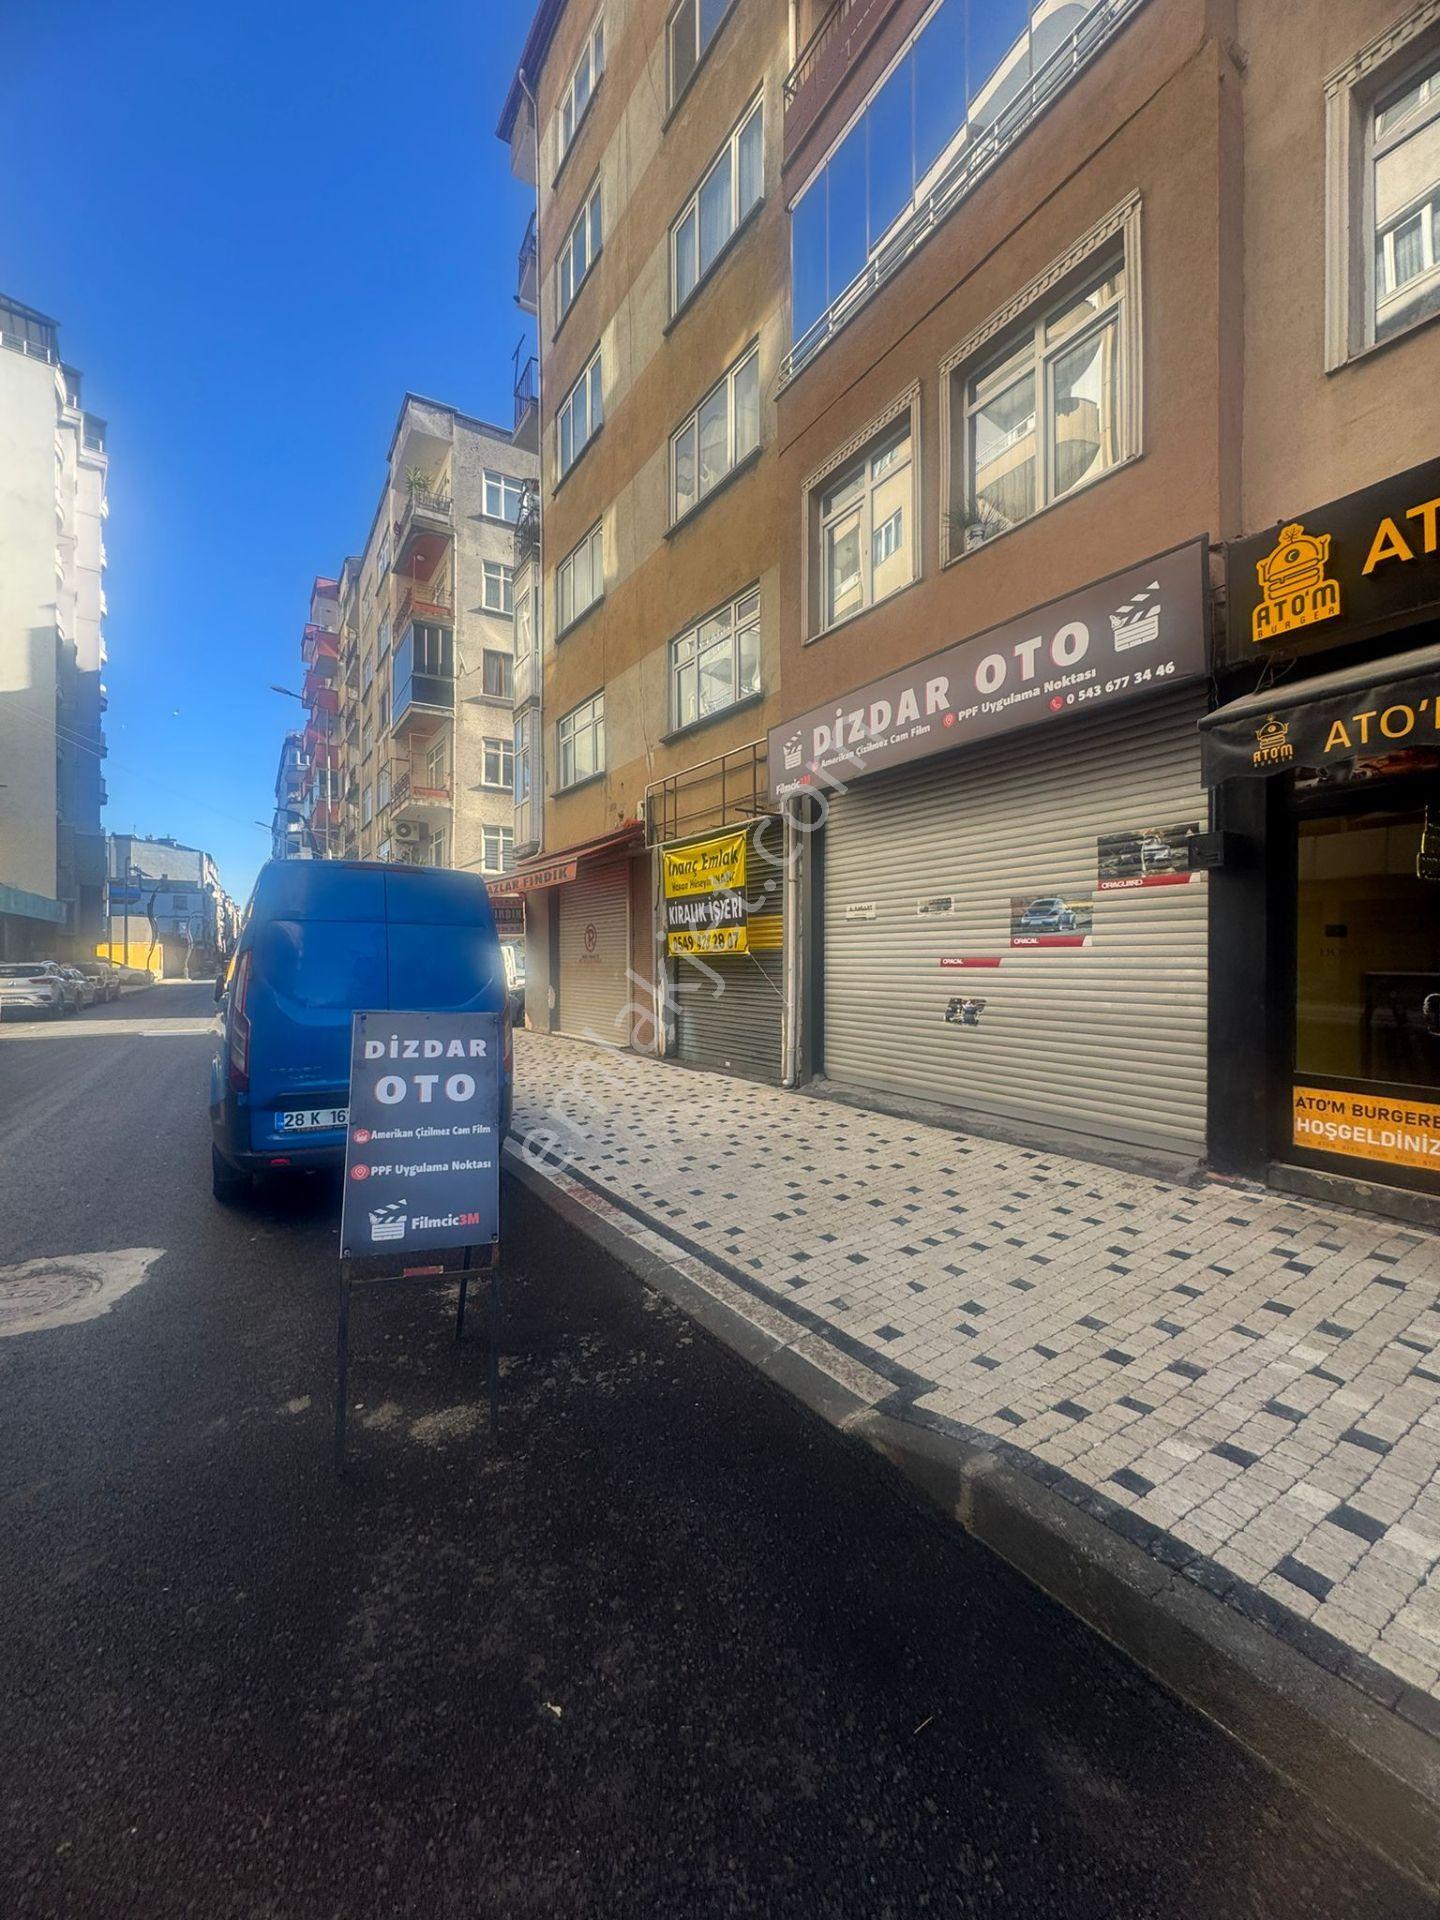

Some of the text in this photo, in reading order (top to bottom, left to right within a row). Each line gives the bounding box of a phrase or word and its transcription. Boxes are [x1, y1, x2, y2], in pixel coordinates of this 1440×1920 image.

[812, 621, 1090, 758] DİZDAR OTO
[1066, 660, 1176, 705] 0 543 677 34 46
[958, 668, 1097, 722] PPF Uygulama Noktası
[889, 731, 909, 745] Cam
[910, 723, 931, 738] Film
[1323, 695, 1440, 753] ATO'
[701, 847, 740, 871] Emlak
[522, 866, 569, 888] FINDIK
[668, 900, 708, 926] KİRALIK
[713, 932, 726, 949] 28
[364, 1034, 487, 1059] DİZDAR
[374, 1073, 476, 1105] OTO
[1295, 1096, 1346, 1115] ATO'M
[284, 1109, 349, 1127] 28 K 16
[371, 1123, 491, 1140] Amerikan Çizilmez Cam Film
[1296, 1117, 1440, 1157] HOŞGELDİNİZ
[371, 1159, 491, 1177] PPF Uygulama Noktası
[411, 1212, 481, 1230] Filmcic3M
